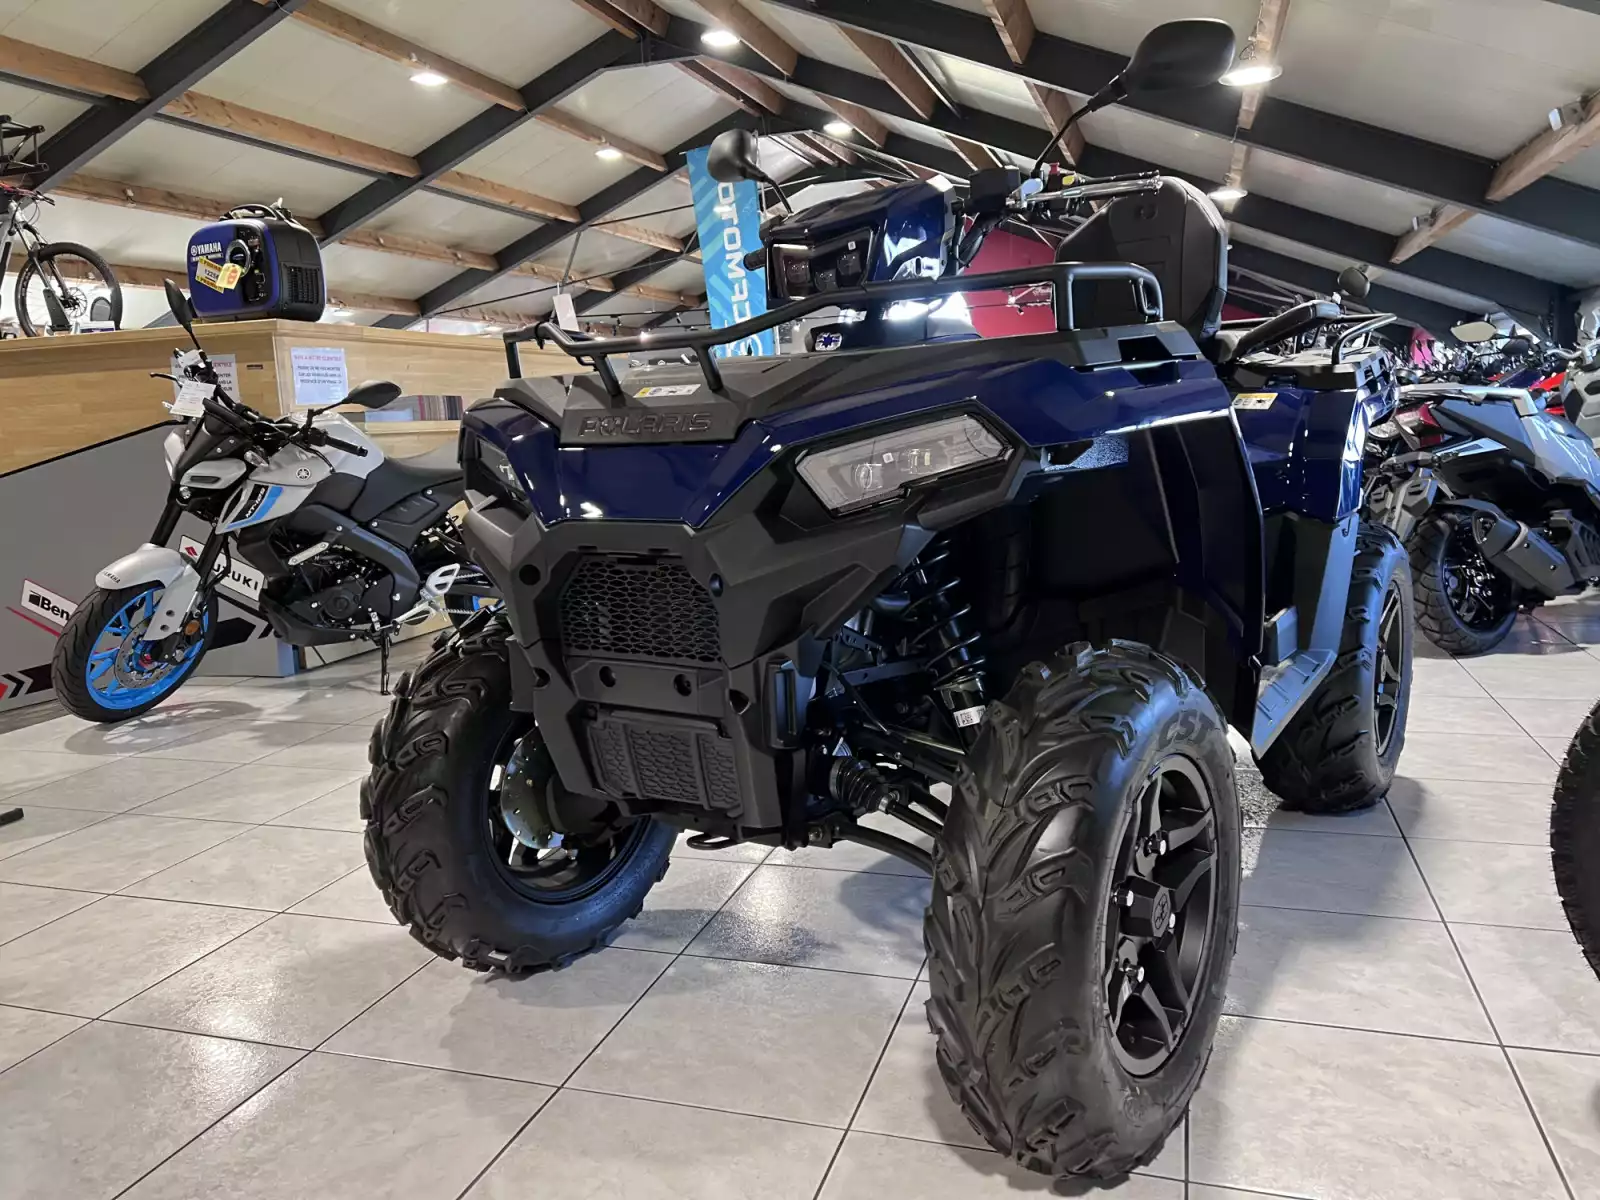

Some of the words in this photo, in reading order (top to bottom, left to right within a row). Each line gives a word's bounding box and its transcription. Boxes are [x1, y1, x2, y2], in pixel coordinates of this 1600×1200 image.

[197, 241, 222, 255] YAMAHA
[578, 412, 712, 437] POLARIS
[1158, 709, 1216, 750] CST
